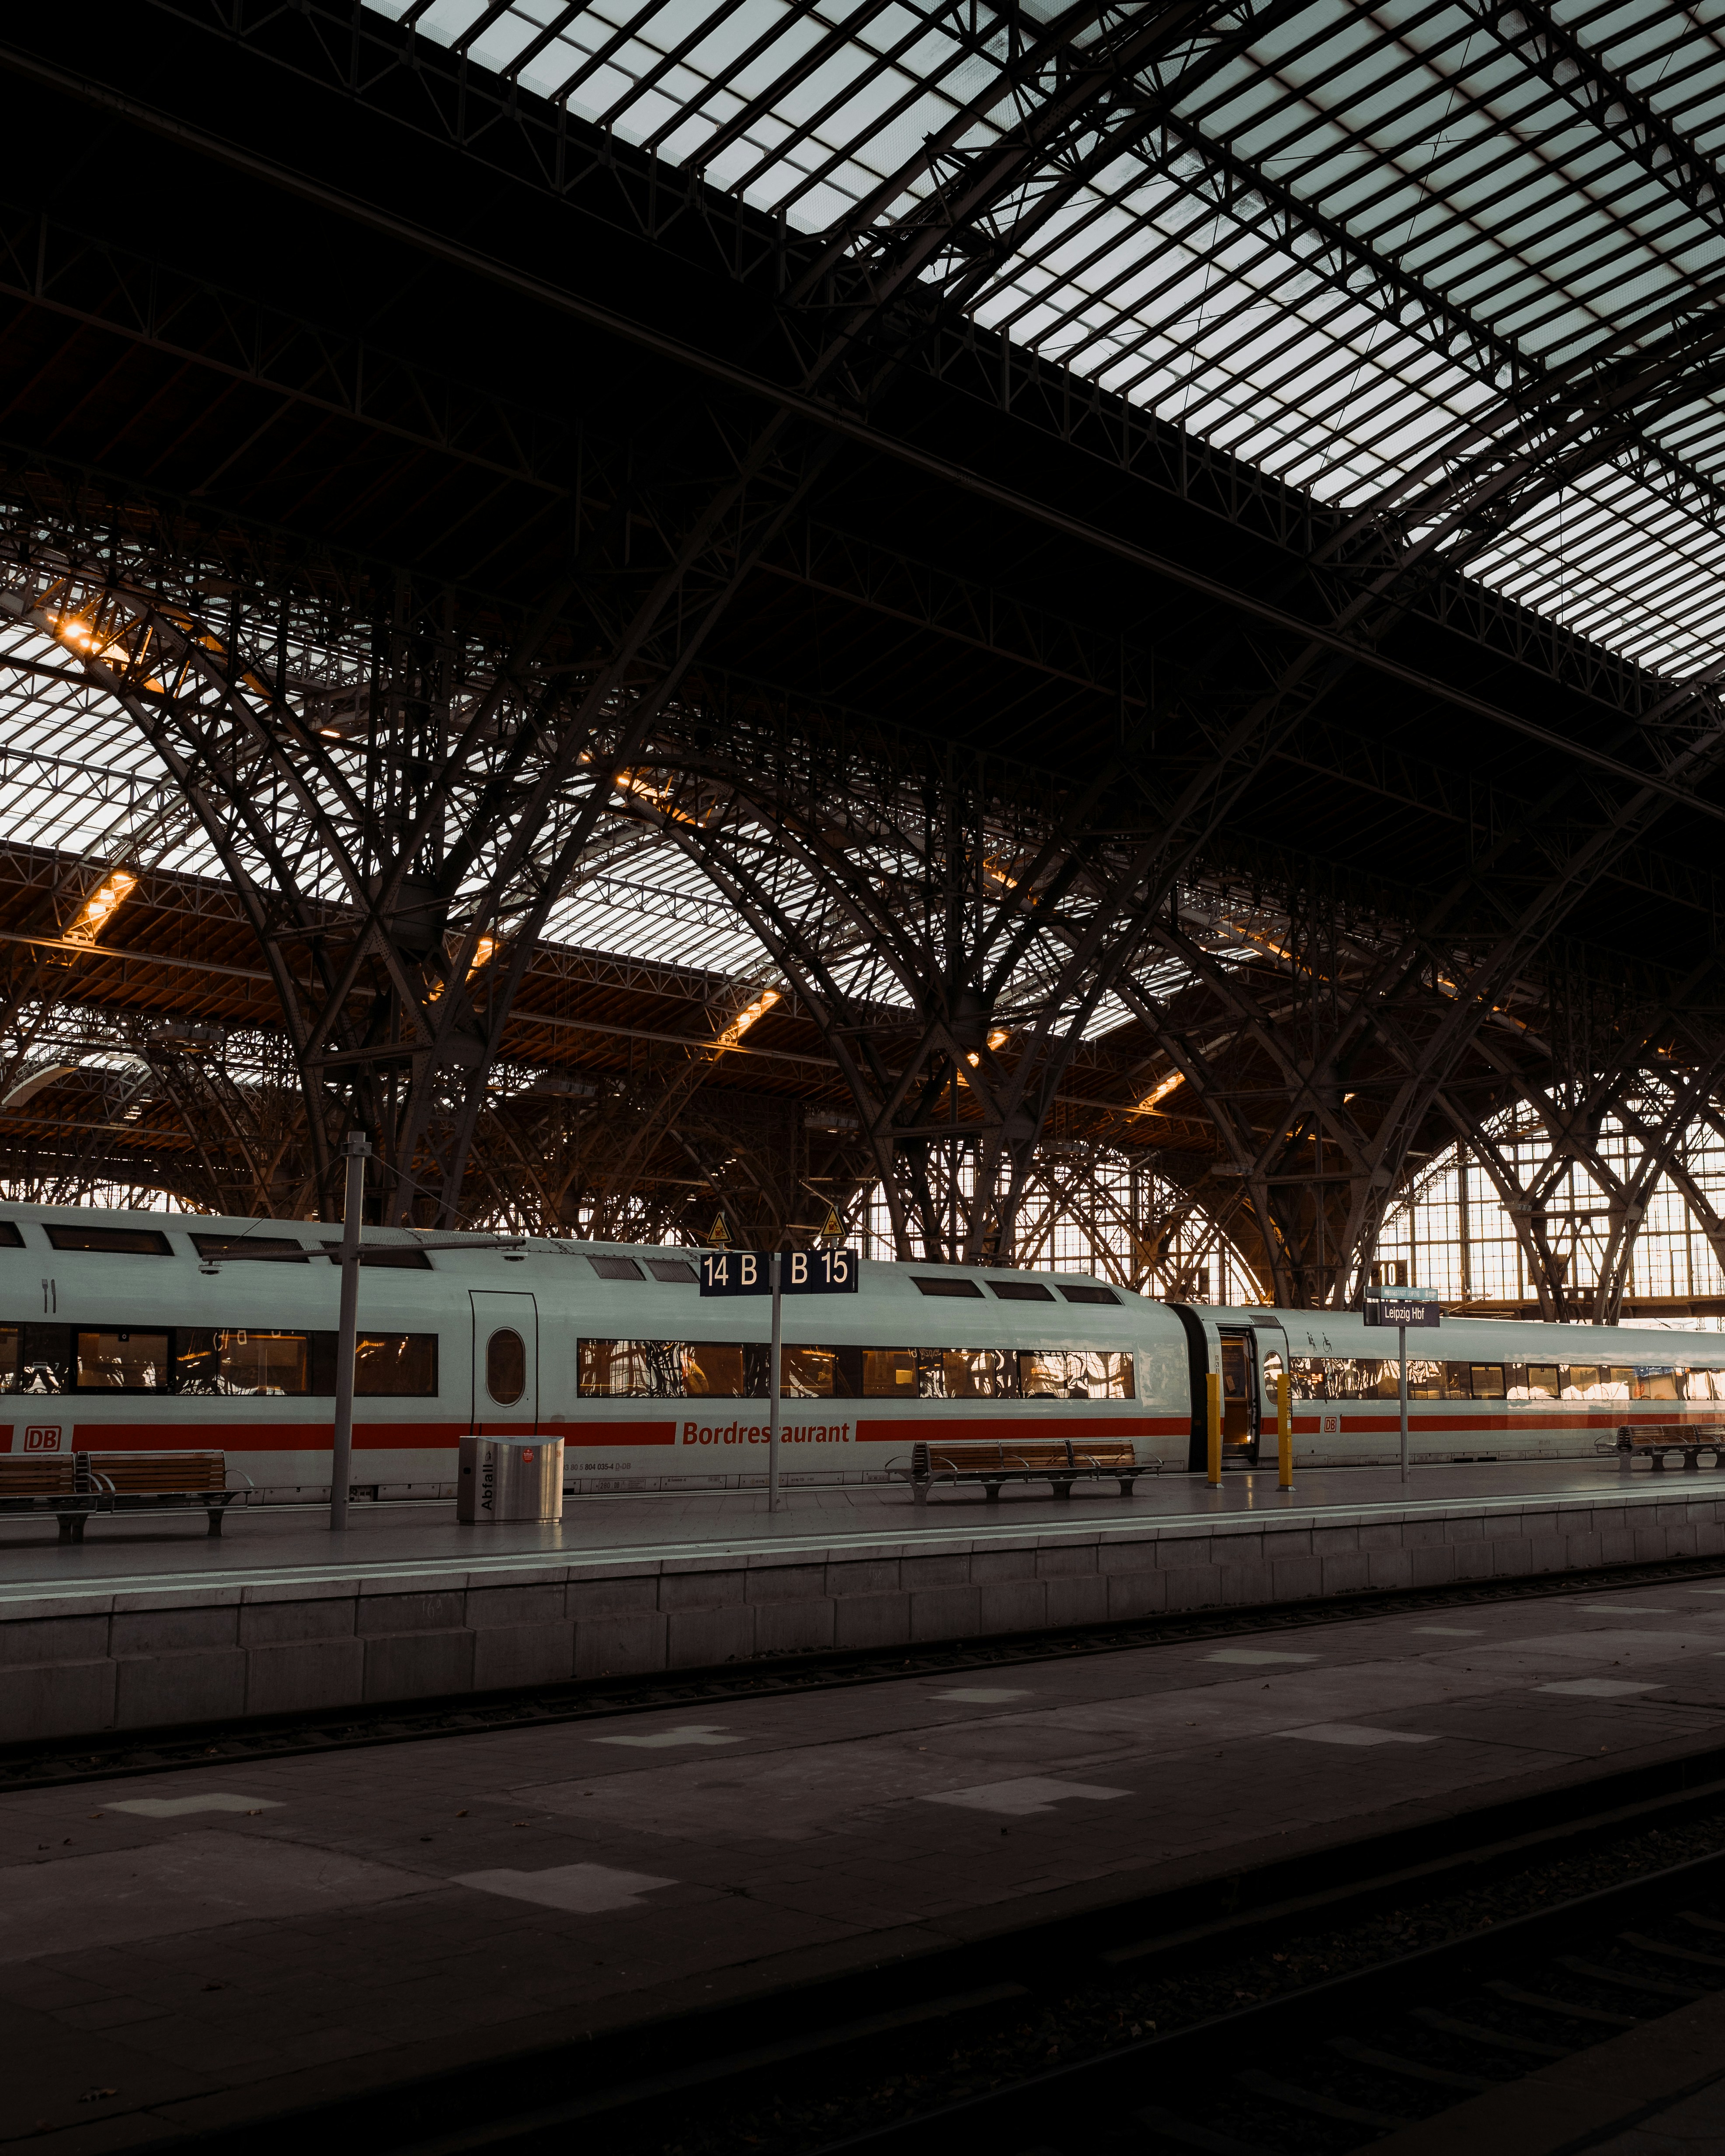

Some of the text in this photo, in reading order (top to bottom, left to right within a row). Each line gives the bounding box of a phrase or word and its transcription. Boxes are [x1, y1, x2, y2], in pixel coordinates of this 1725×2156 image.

[704, 1255, 757, 1286] 14 B
[792, 1251, 848, 1284] B 15
[1380, 1263, 1396, 1286] 10
[1384, 1289, 1406, 1297] MESSESTADT
[1385, 1306, 1424, 1321] Leipzig Hbf
[682, 1421, 850, 1445] Bordresaurant
[1325, 1419, 1335, 1430] DB
[28, 1429, 57, 1449] DB
[481, 1464, 494, 1510] Abfall
[422, 1598, 443, 1619] 169
